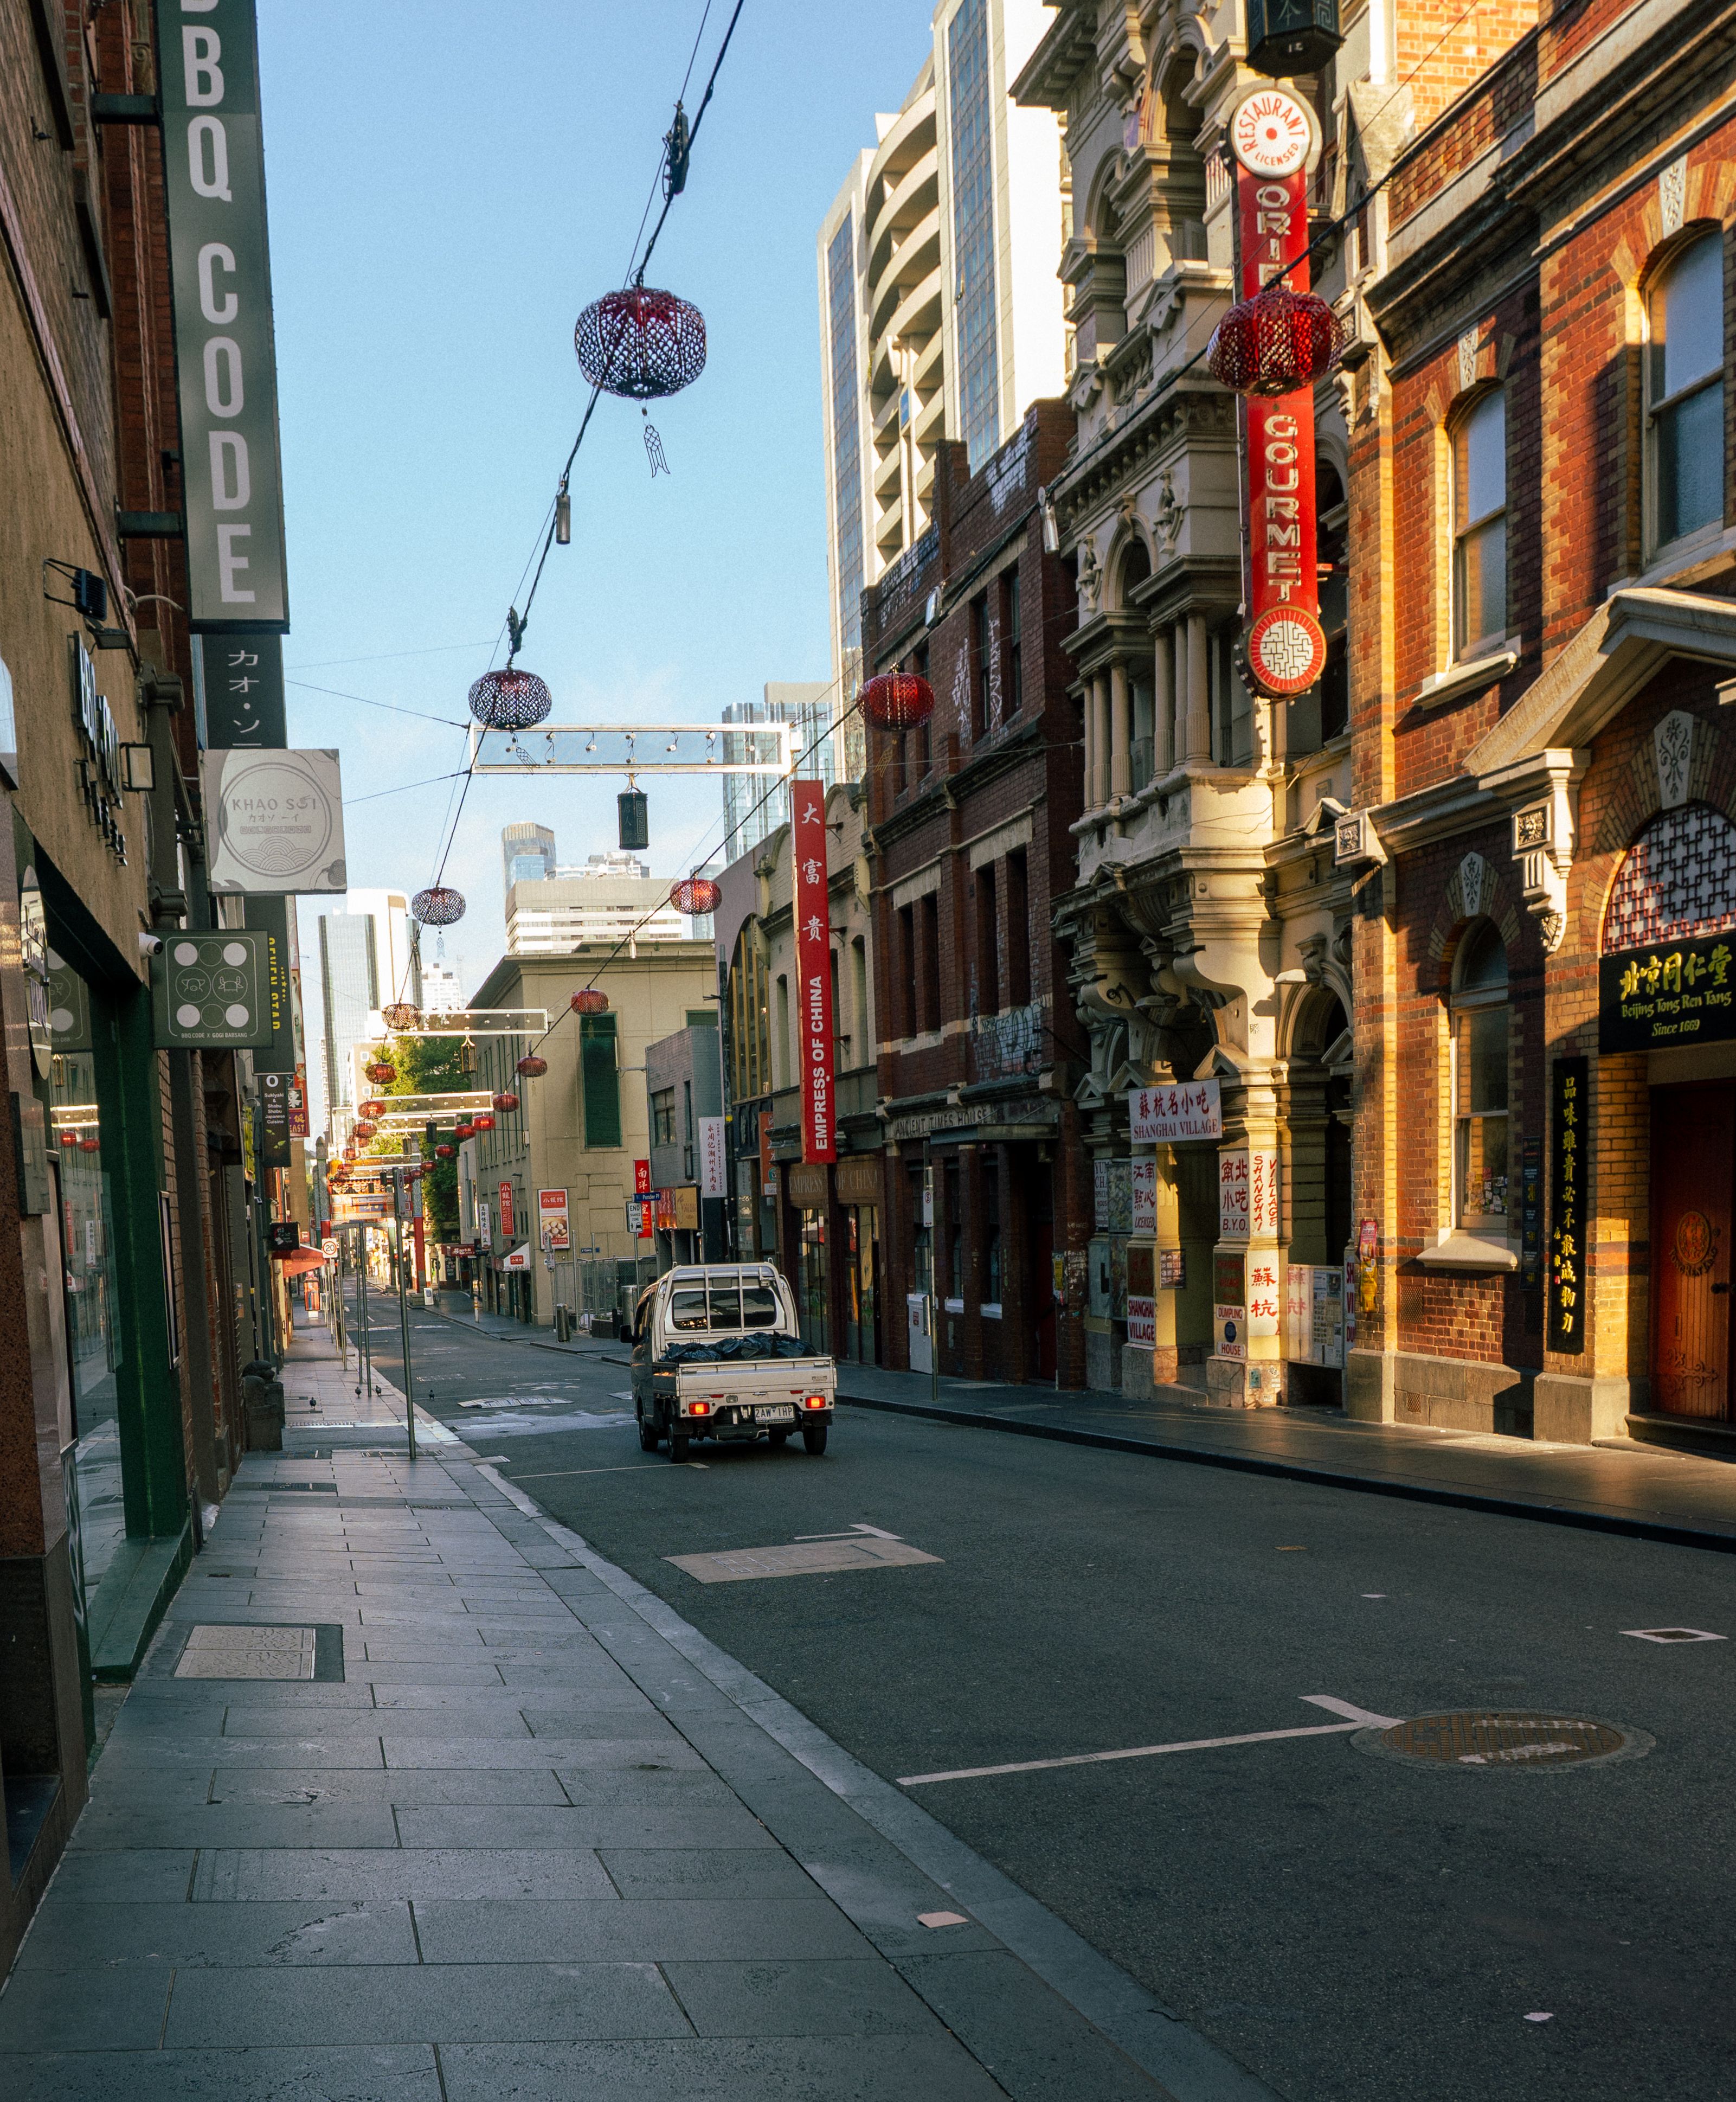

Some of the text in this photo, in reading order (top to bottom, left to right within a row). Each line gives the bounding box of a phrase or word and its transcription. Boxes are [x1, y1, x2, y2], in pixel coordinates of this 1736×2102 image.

[1238, 97, 1306, 153] RESTAURANT
[1255, 142, 1300, 166] LICENSED
[181, 0, 255, 603] BQ CODE
[1264, 415, 1302, 602] GOURMET
[232, 798, 279, 811] KHAO
[801, 802, 823, 943] 大富贵
[1619, 944, 1732, 1001] 北京同仁堂
[1621, 990, 1732, 1019] Beijing Tong Ren Tang
[1651, 1019, 1701, 1036] Since 1669
[811, 976, 828, 1150] EMPRESS OF CHINA
[1138, 1085, 1210, 1121] 蘇杭名小吃
[895, 1108, 988, 1137] ANCIENT TIMES HOUSE
[1133, 1118, 1218, 1140] SHANGHAI VILLAGE
[789, 1169, 878, 1194] EMPRESS OF CHINA
[1095, 1176, 1107, 1189] CH
[1133, 1160, 1156, 1183] 江南
[1223, 1187, 1249, 1213] 小吃
[1253, 1155, 1264, 1232] SHANGHAI
[1268, 1158, 1278, 1227] VILLAGE
[1134, 1216, 1155, 1228] LICENSED
[1250, 1267, 1277, 1318] 蘇杭
[1128, 1299, 1154, 1318] SHANGHAI
[1218, 1307, 1243, 1319] DUMPLING
[1129, 1322, 1154, 1342] VILLAGE
[1221, 1343, 1241, 1356] HOUSE
[755, 1407, 792, 1418] 2AW 1HP
